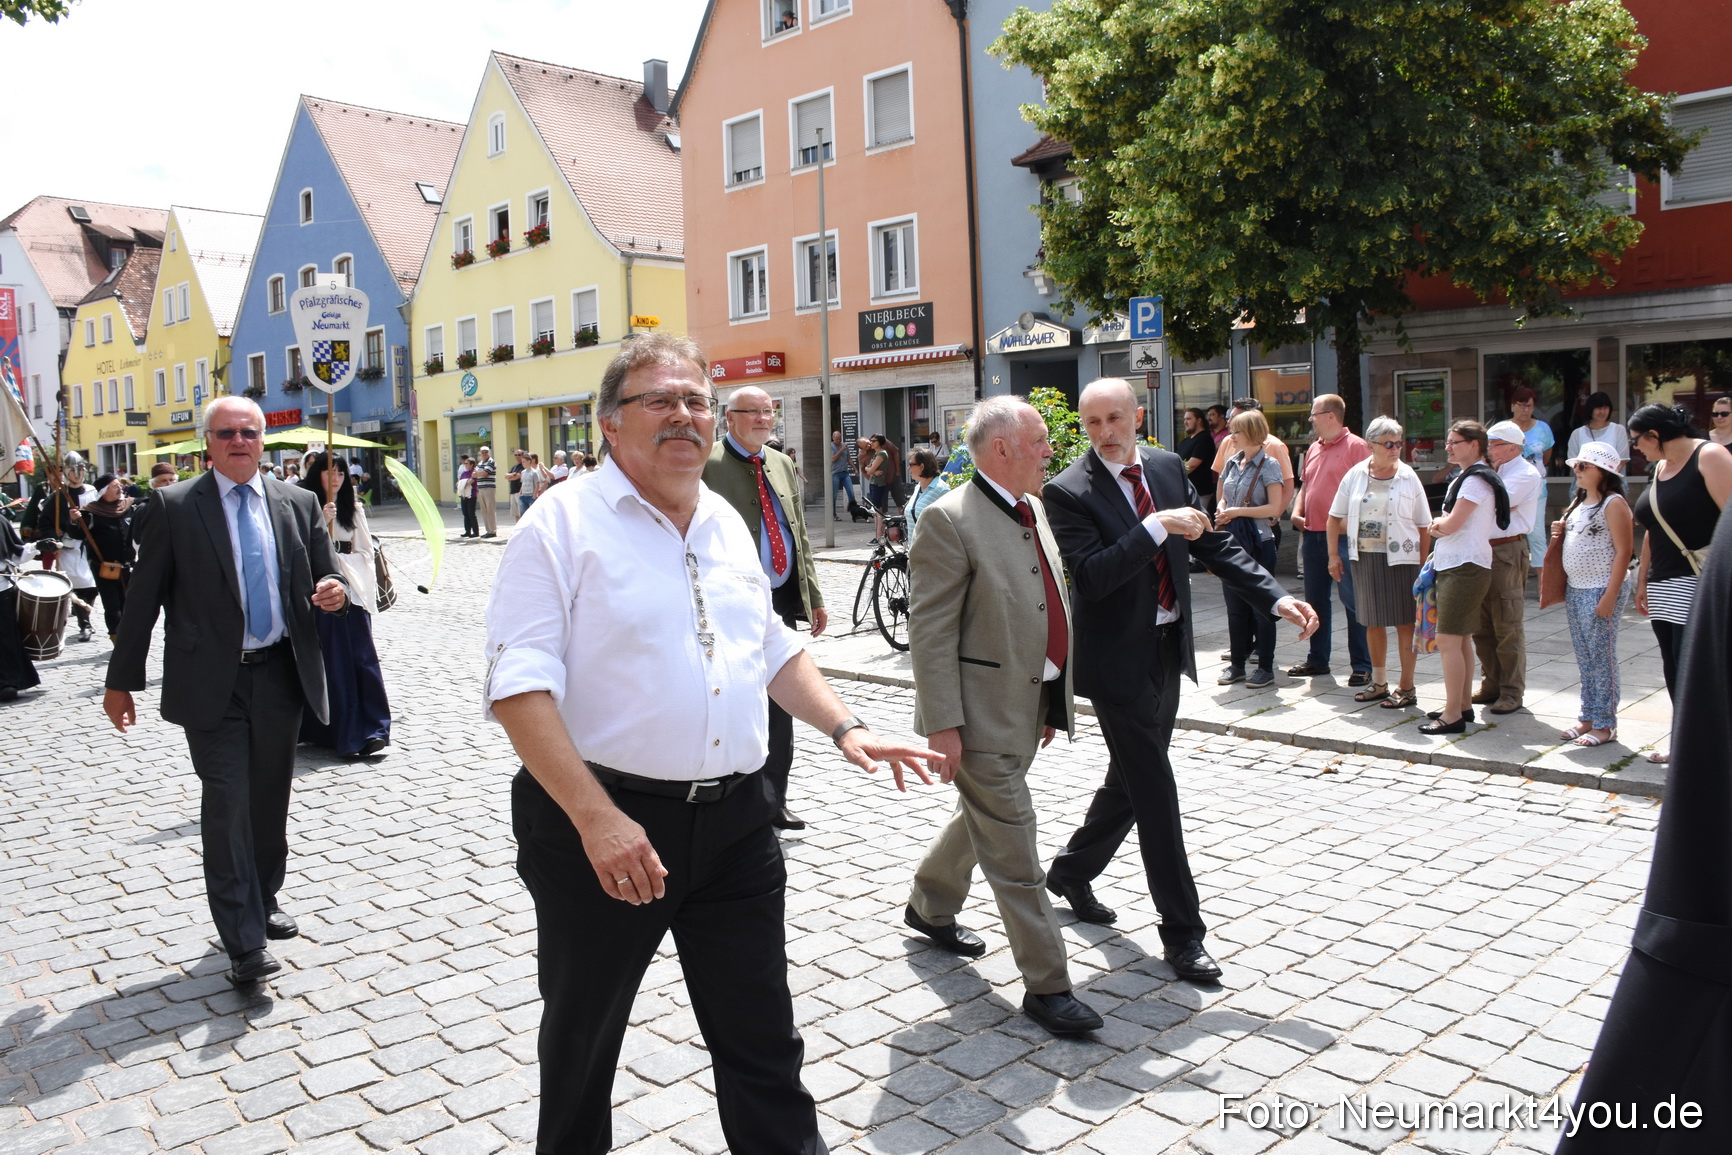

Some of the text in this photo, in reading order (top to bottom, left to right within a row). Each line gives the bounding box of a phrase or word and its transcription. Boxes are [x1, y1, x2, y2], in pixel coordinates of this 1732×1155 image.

[330, 280, 337, 291] 5
[299, 294, 363, 310] Pfalzgräfisches
[312, 319, 350, 330] Neumarkt
[1137, 302, 1155, 334] P
[871, 342, 887, 350] OBST
[894, 338, 920, 347] GEMÜSE
[1000, 331, 1056, 349] MÜHLBAUER
[768, 355, 781, 367] DER
[96, 360, 116, 376] HOTEL
[711, 364, 726, 378] DER
[991, 376, 1000, 385] 16
[195, 387, 200, 403] P
[98, 429, 125, 439] Restaurant
